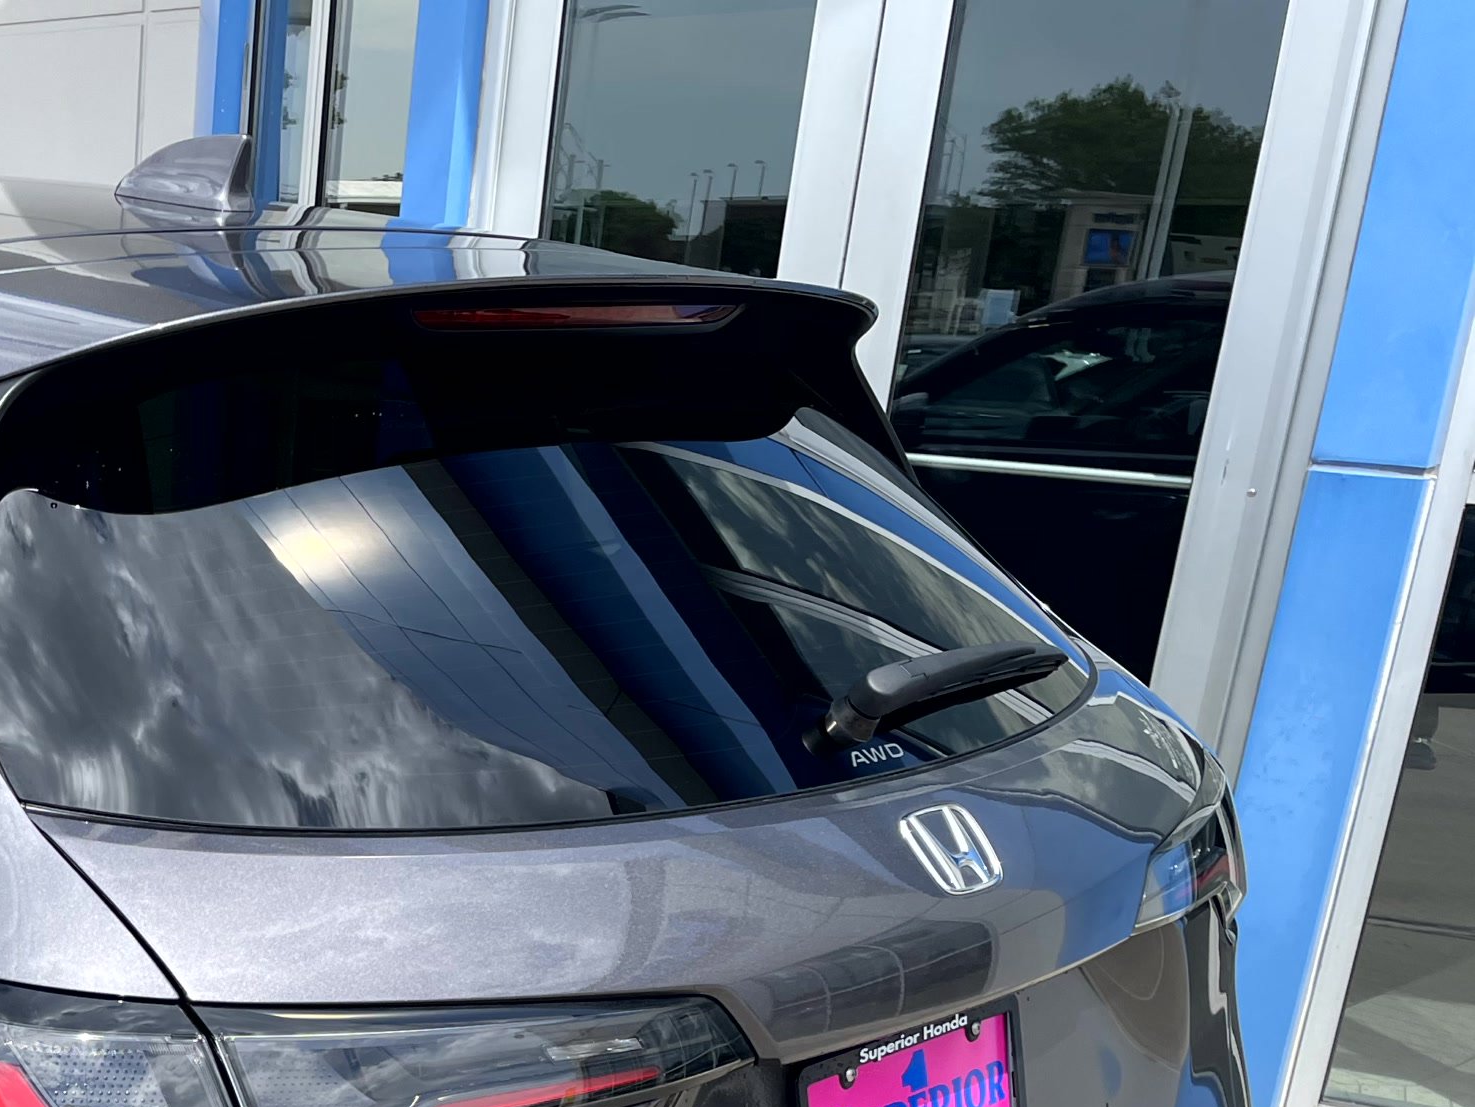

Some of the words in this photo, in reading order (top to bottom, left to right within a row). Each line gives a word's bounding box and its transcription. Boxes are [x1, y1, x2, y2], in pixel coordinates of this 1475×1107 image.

[850, 743, 904, 767] AWD
[859, 1032, 921, 1063] Superior
[923, 1013, 968, 1041] Honda
